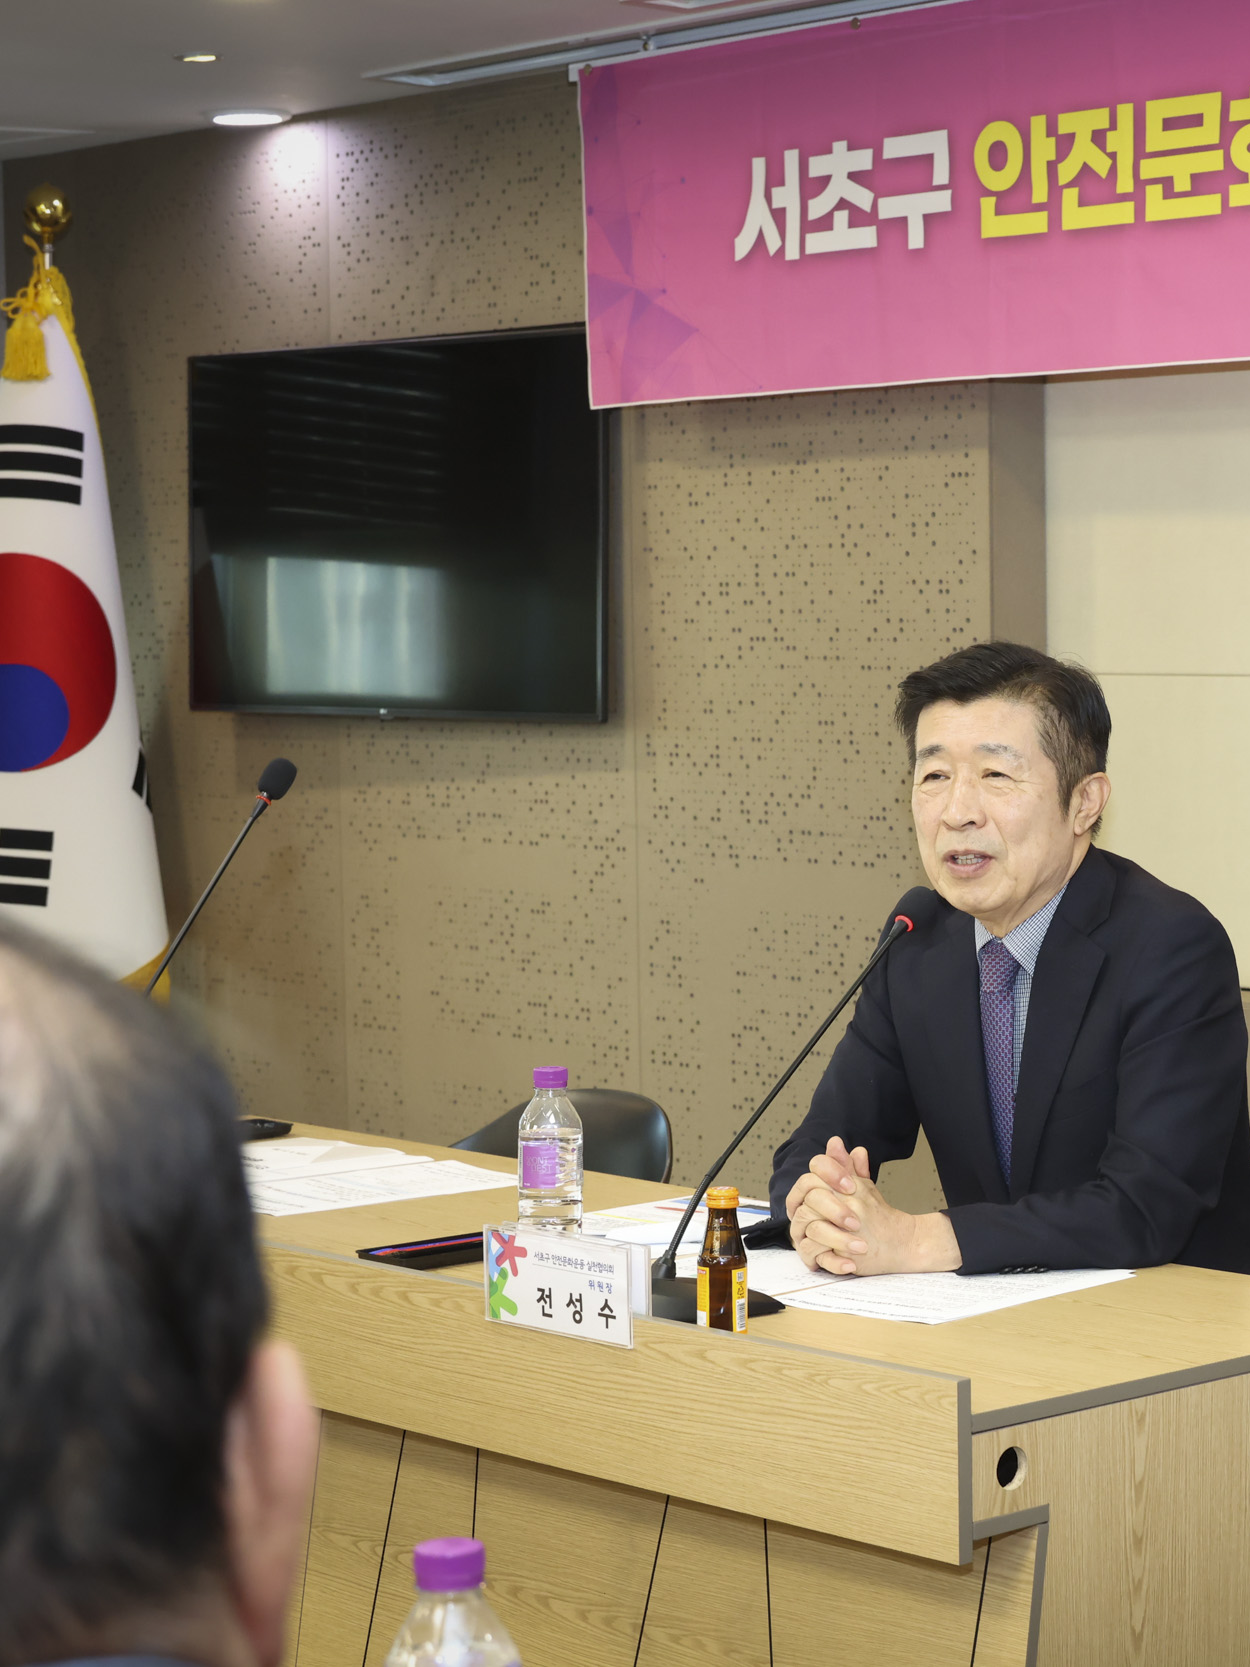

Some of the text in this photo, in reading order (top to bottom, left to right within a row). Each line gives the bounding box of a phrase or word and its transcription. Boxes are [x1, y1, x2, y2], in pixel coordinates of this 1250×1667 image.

[734, 128, 953, 263] 서초구
[533, 1250, 615, 1275] 서초구 안전문화운동 실천협의회
